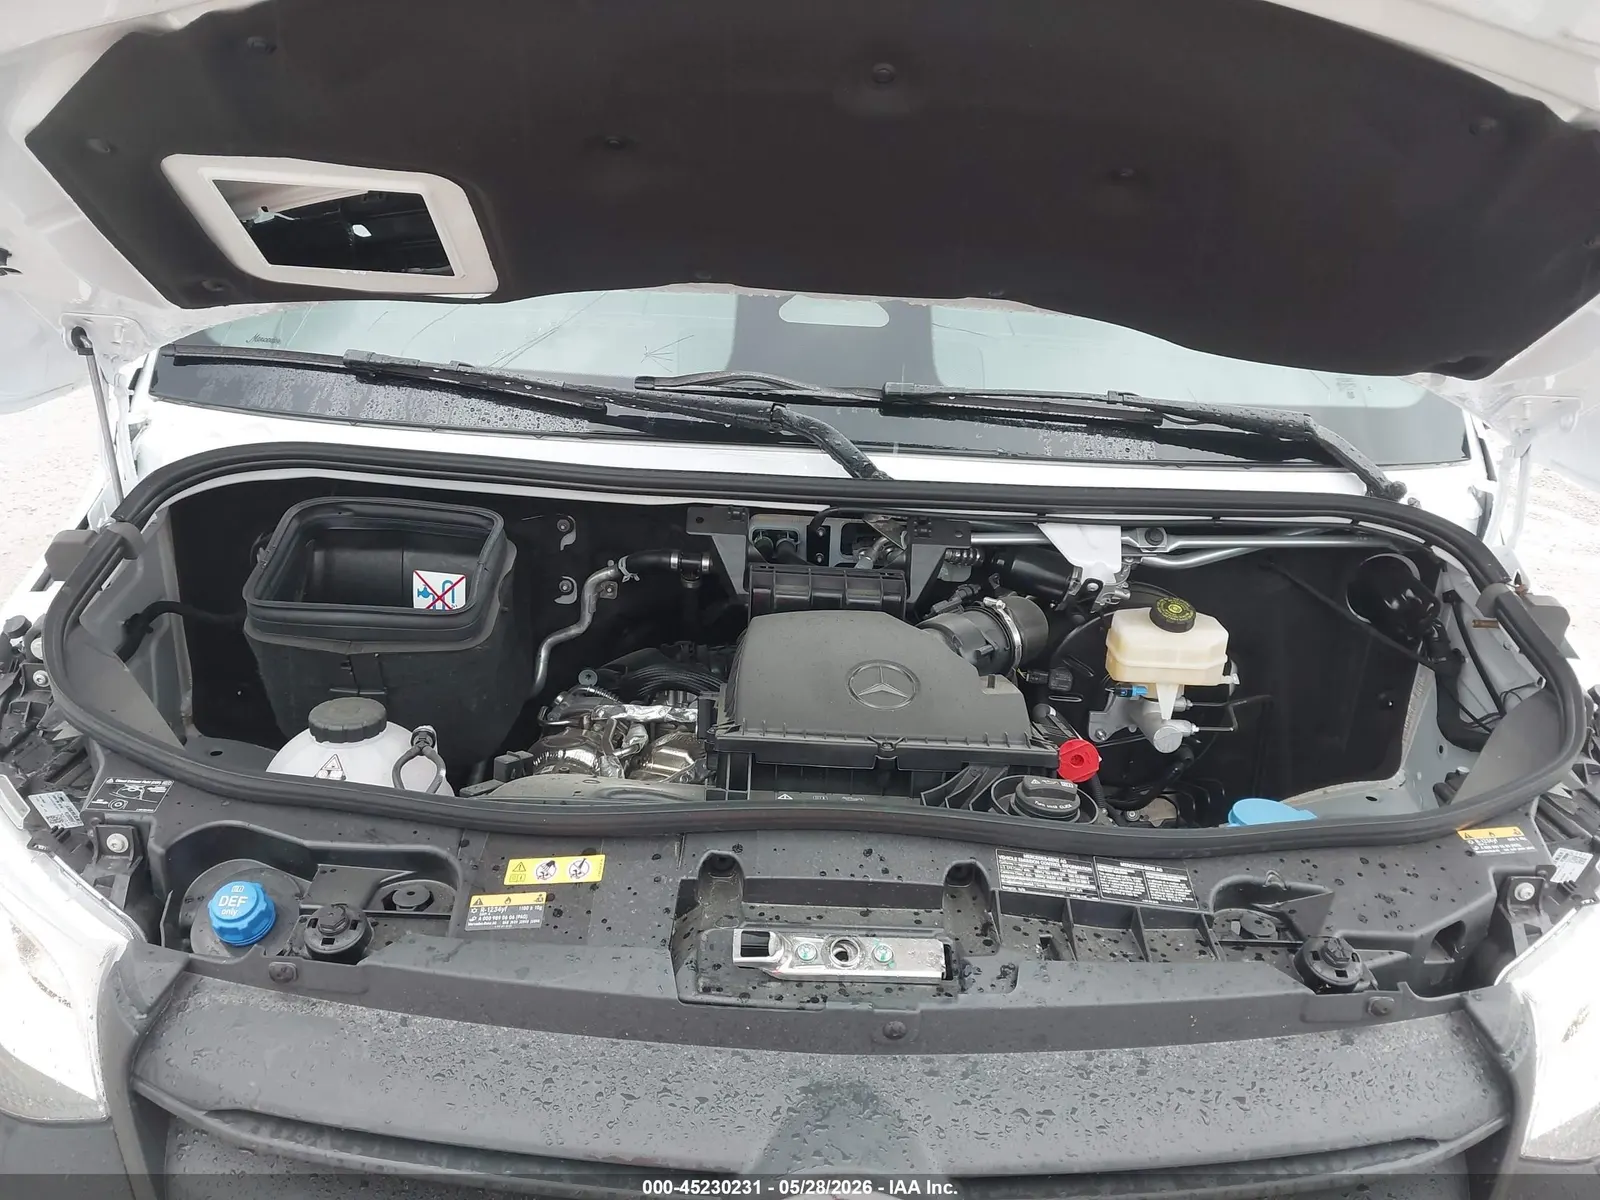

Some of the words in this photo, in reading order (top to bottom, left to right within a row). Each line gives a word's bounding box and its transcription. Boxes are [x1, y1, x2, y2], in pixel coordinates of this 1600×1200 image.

[218, 895, 249, 907] DEF
[221, 908, 239, 916] only
[480, 905, 509, 913] R-1234yf
